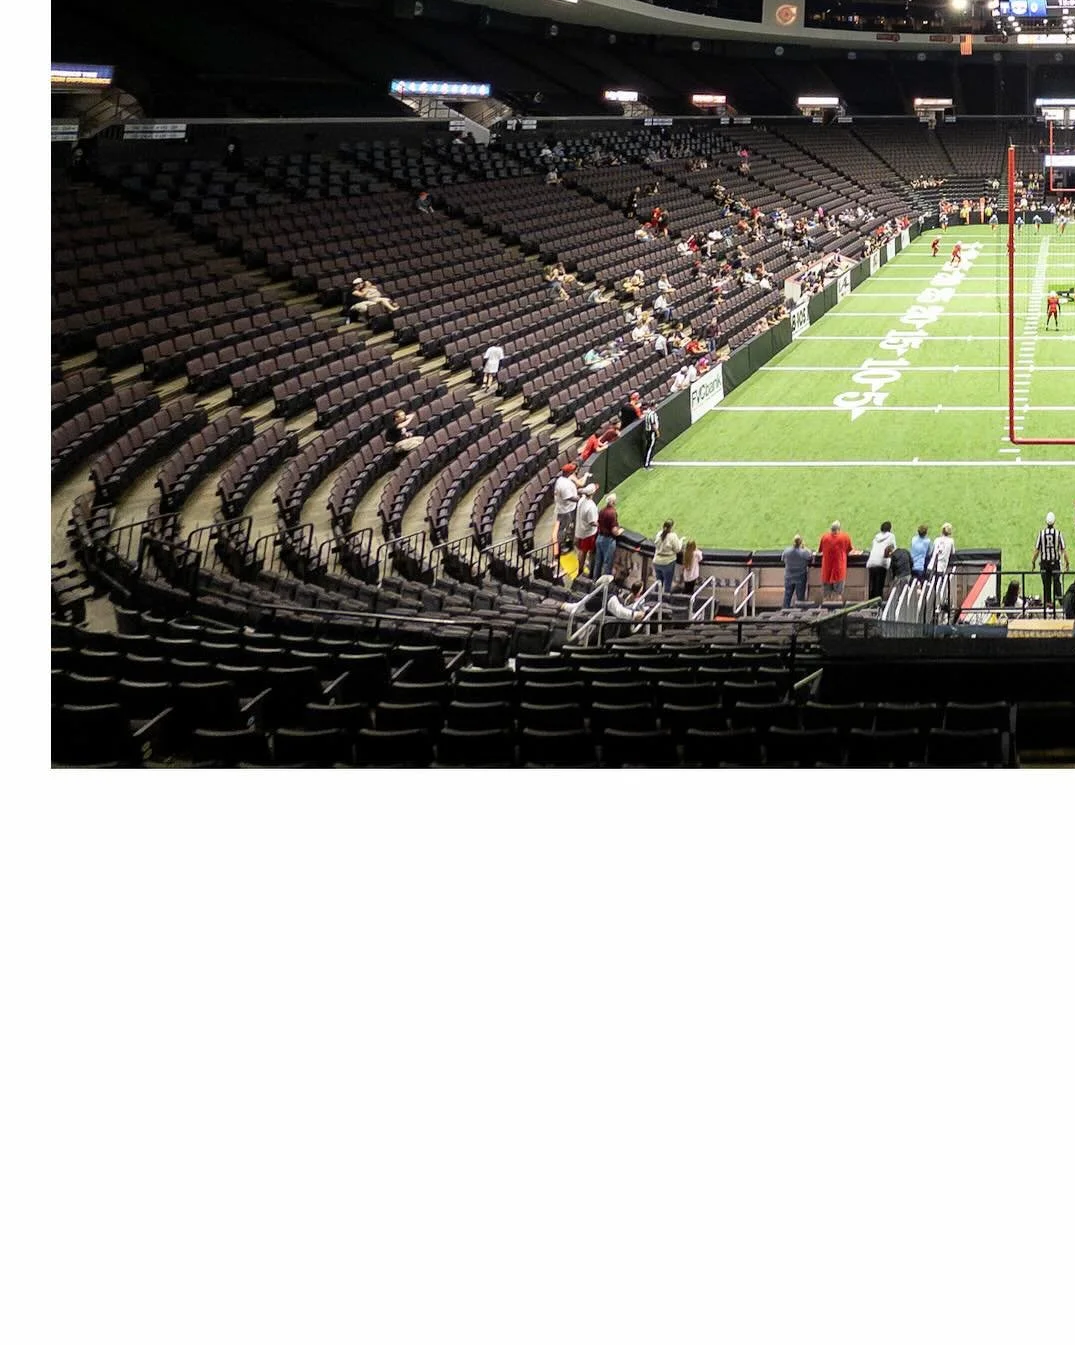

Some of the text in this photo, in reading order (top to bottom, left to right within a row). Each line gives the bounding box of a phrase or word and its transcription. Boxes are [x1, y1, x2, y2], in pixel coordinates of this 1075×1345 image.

[852, 358, 911, 384] 10
[833, 391, 890, 408] 5
[1046, 533, 1054, 547] R
